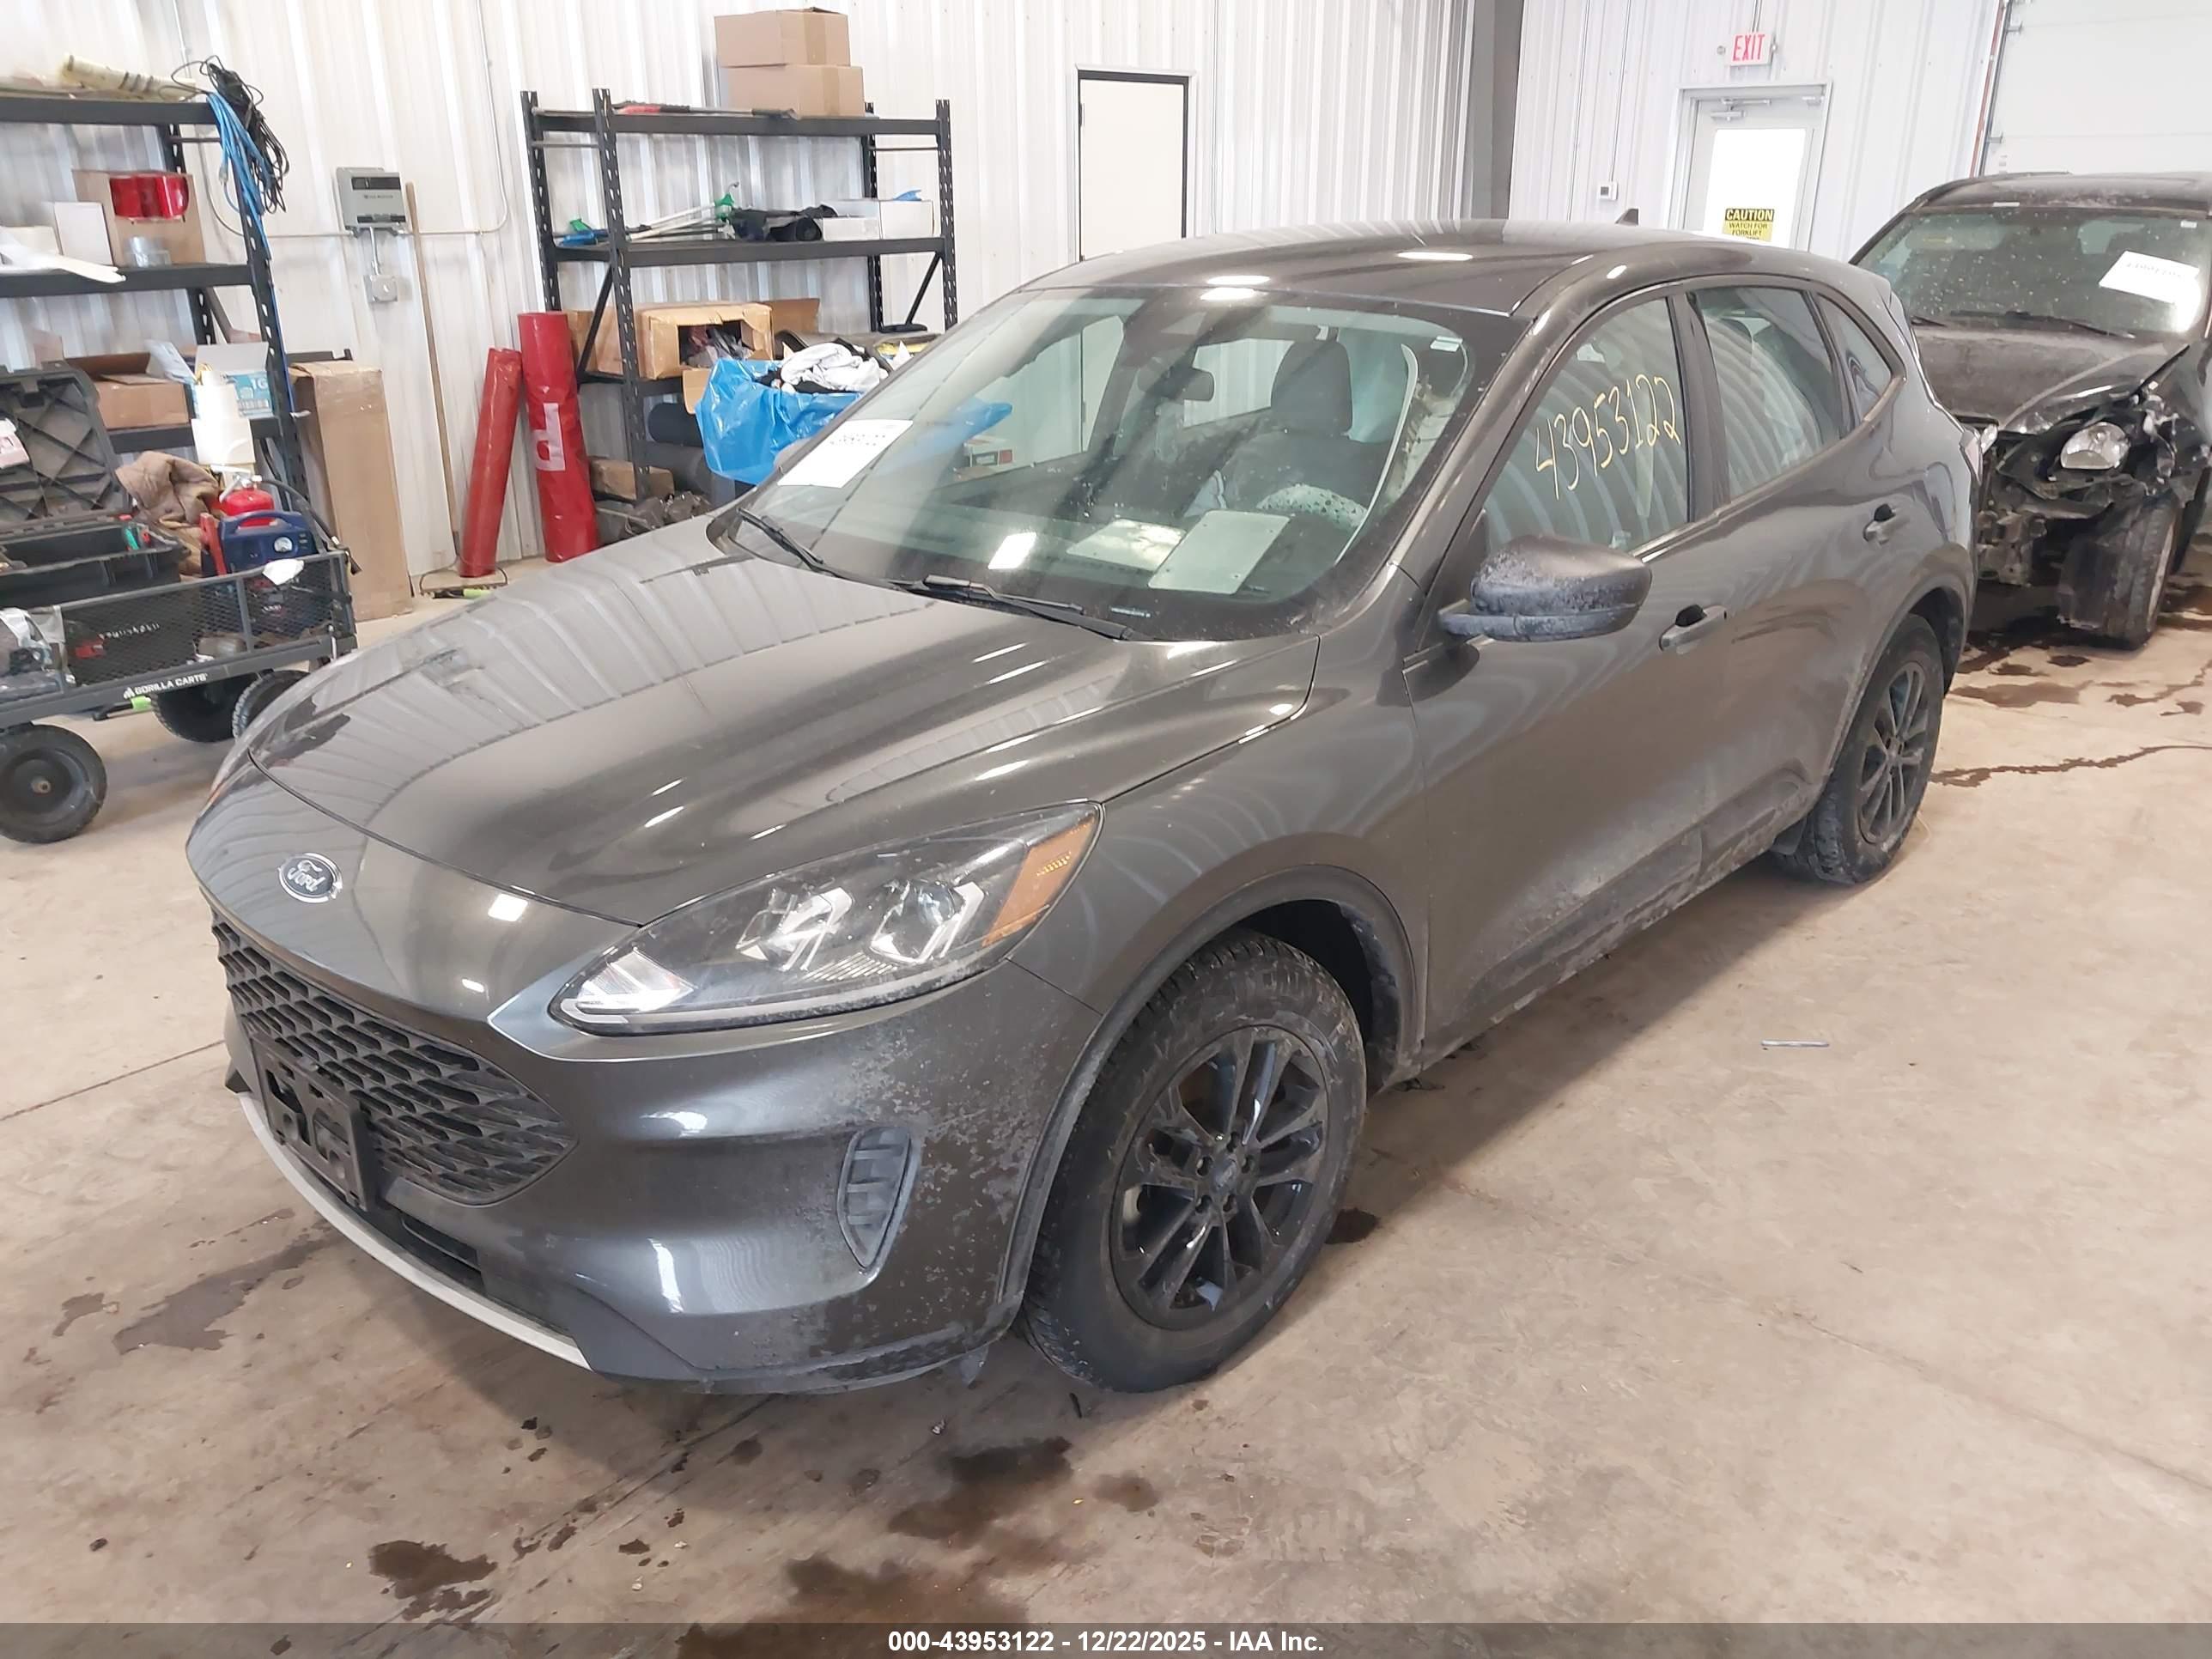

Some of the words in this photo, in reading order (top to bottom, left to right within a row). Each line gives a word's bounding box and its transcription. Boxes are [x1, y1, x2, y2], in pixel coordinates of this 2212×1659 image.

[1733, 33, 1765, 61] EXIT
[1726, 210, 1773, 222] CAUTION
[1534, 374, 1681, 501] 43953122
[134, 680, 174, 696] GORILLA
